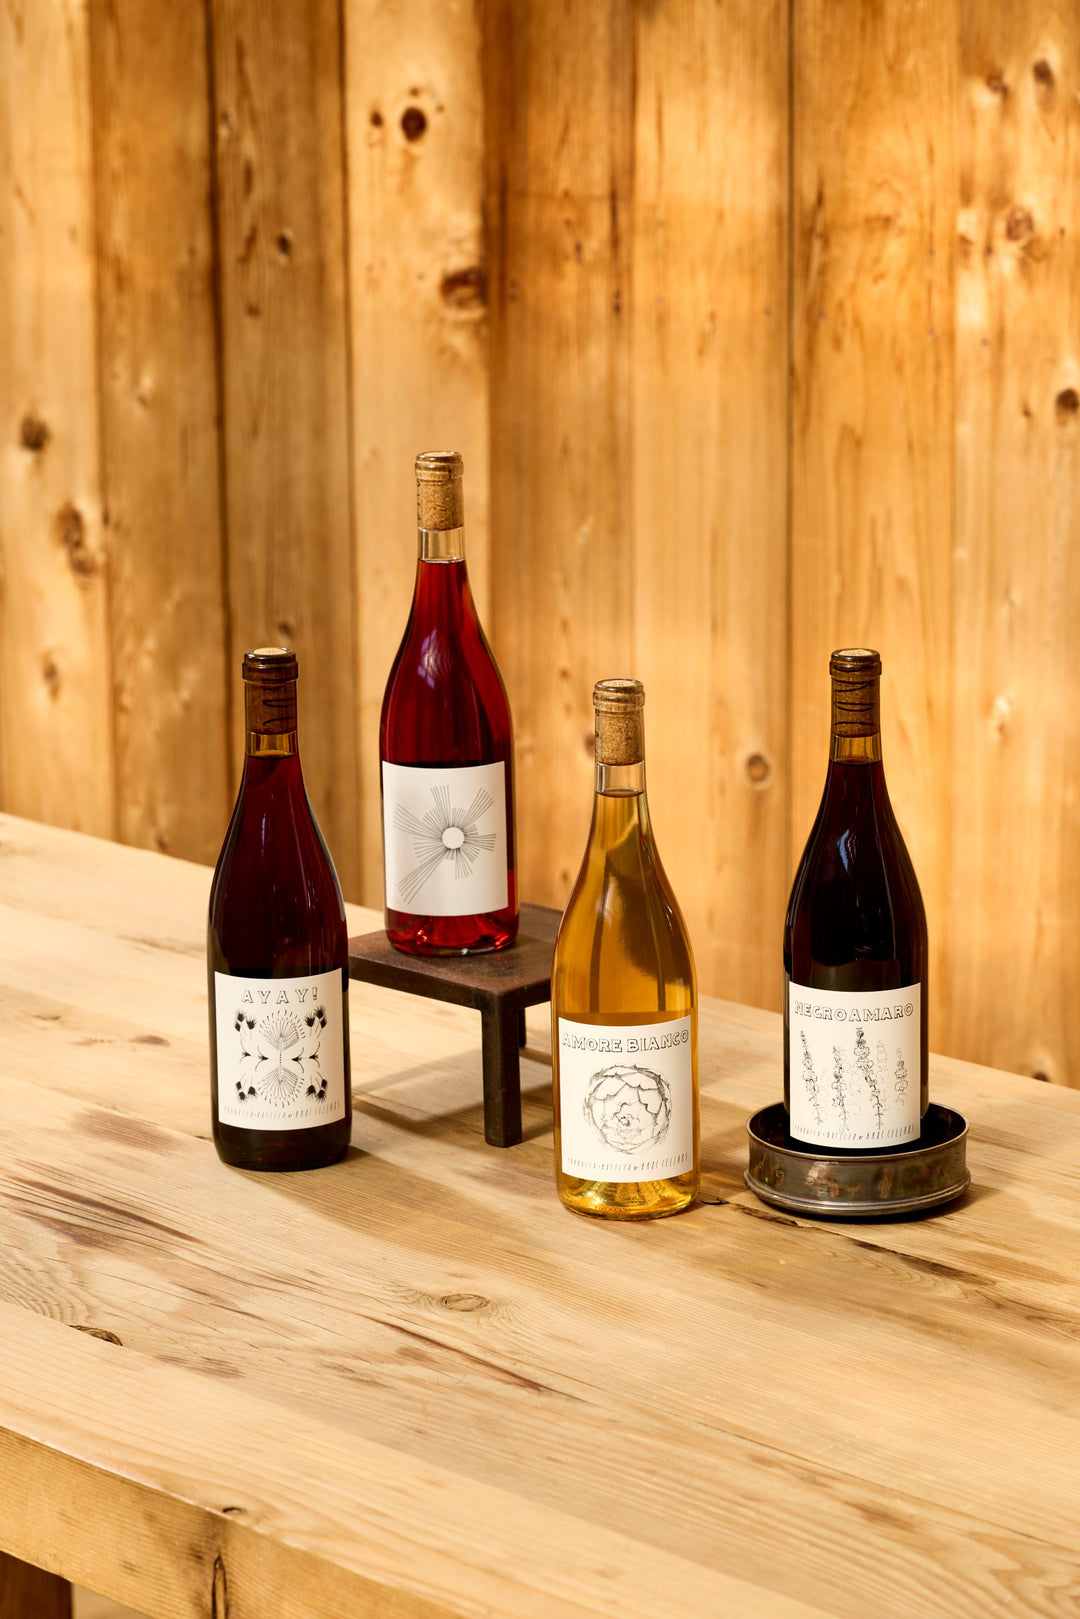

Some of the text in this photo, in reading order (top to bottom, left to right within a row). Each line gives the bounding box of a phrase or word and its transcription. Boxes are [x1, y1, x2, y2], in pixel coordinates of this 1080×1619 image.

[241, 986, 318, 1005] AYAY!
[561, 1029, 690, 1053] AMORE BIANCO
